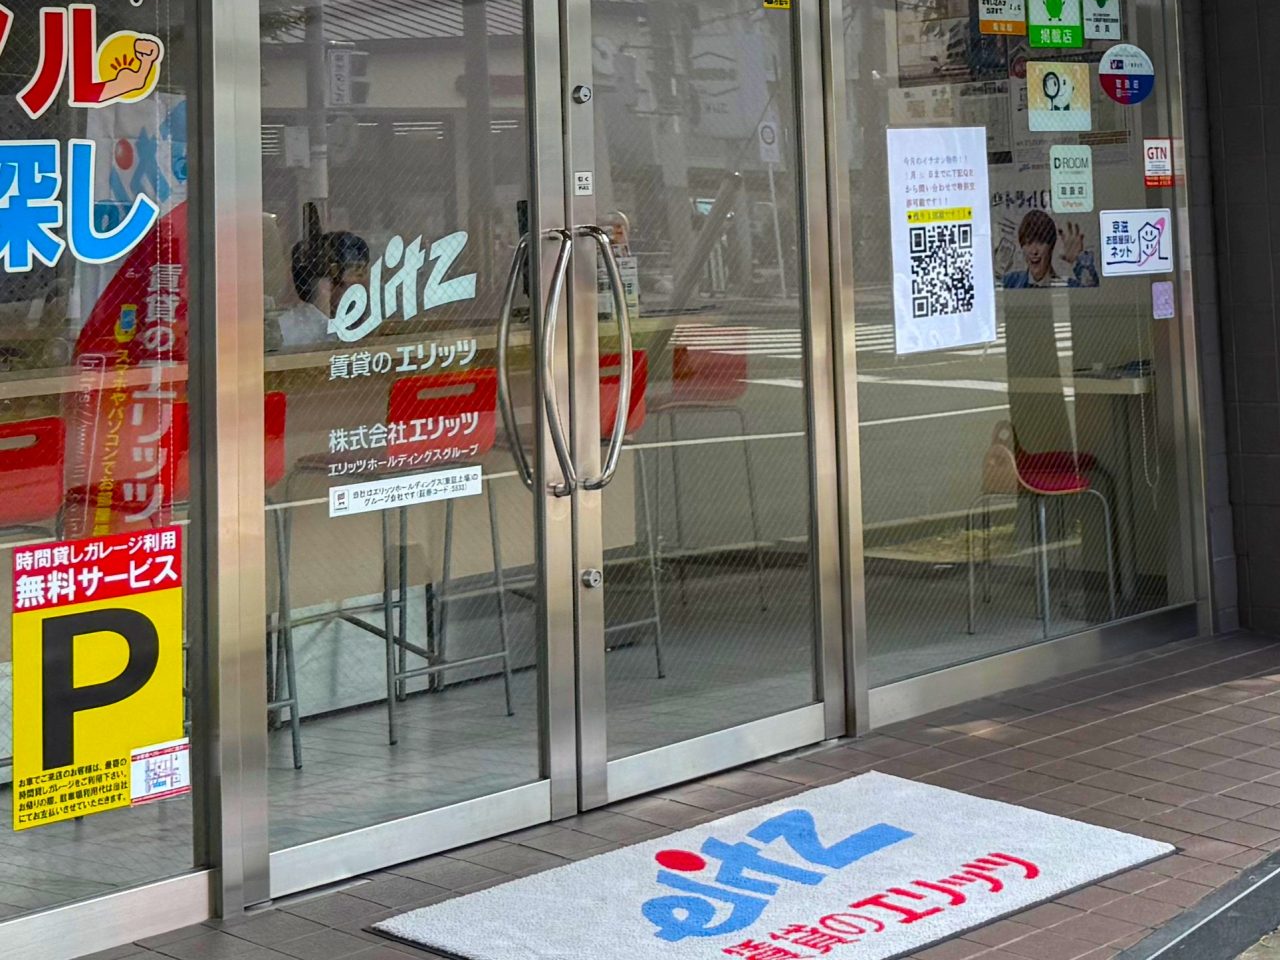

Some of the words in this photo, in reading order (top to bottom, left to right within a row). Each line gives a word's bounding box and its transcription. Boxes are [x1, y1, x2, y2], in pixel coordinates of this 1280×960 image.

[1146, 146, 1168, 160] GTN
[1110, 245, 1133, 259] ネット
[327, 230, 478, 343] elitz
[122, 263, 184, 524] 賃貸のエリッツ
[328, 411, 480, 455] 株式会社エリッツ
[327, 443, 480, 478] エリッツホールディングスグループ
[15, 531, 177, 572] 時間貸しガレージ利用
[15, 555, 179, 609] 無料サービス
[42, 607, 160, 771] P
[640, 808, 914, 942] elitz
